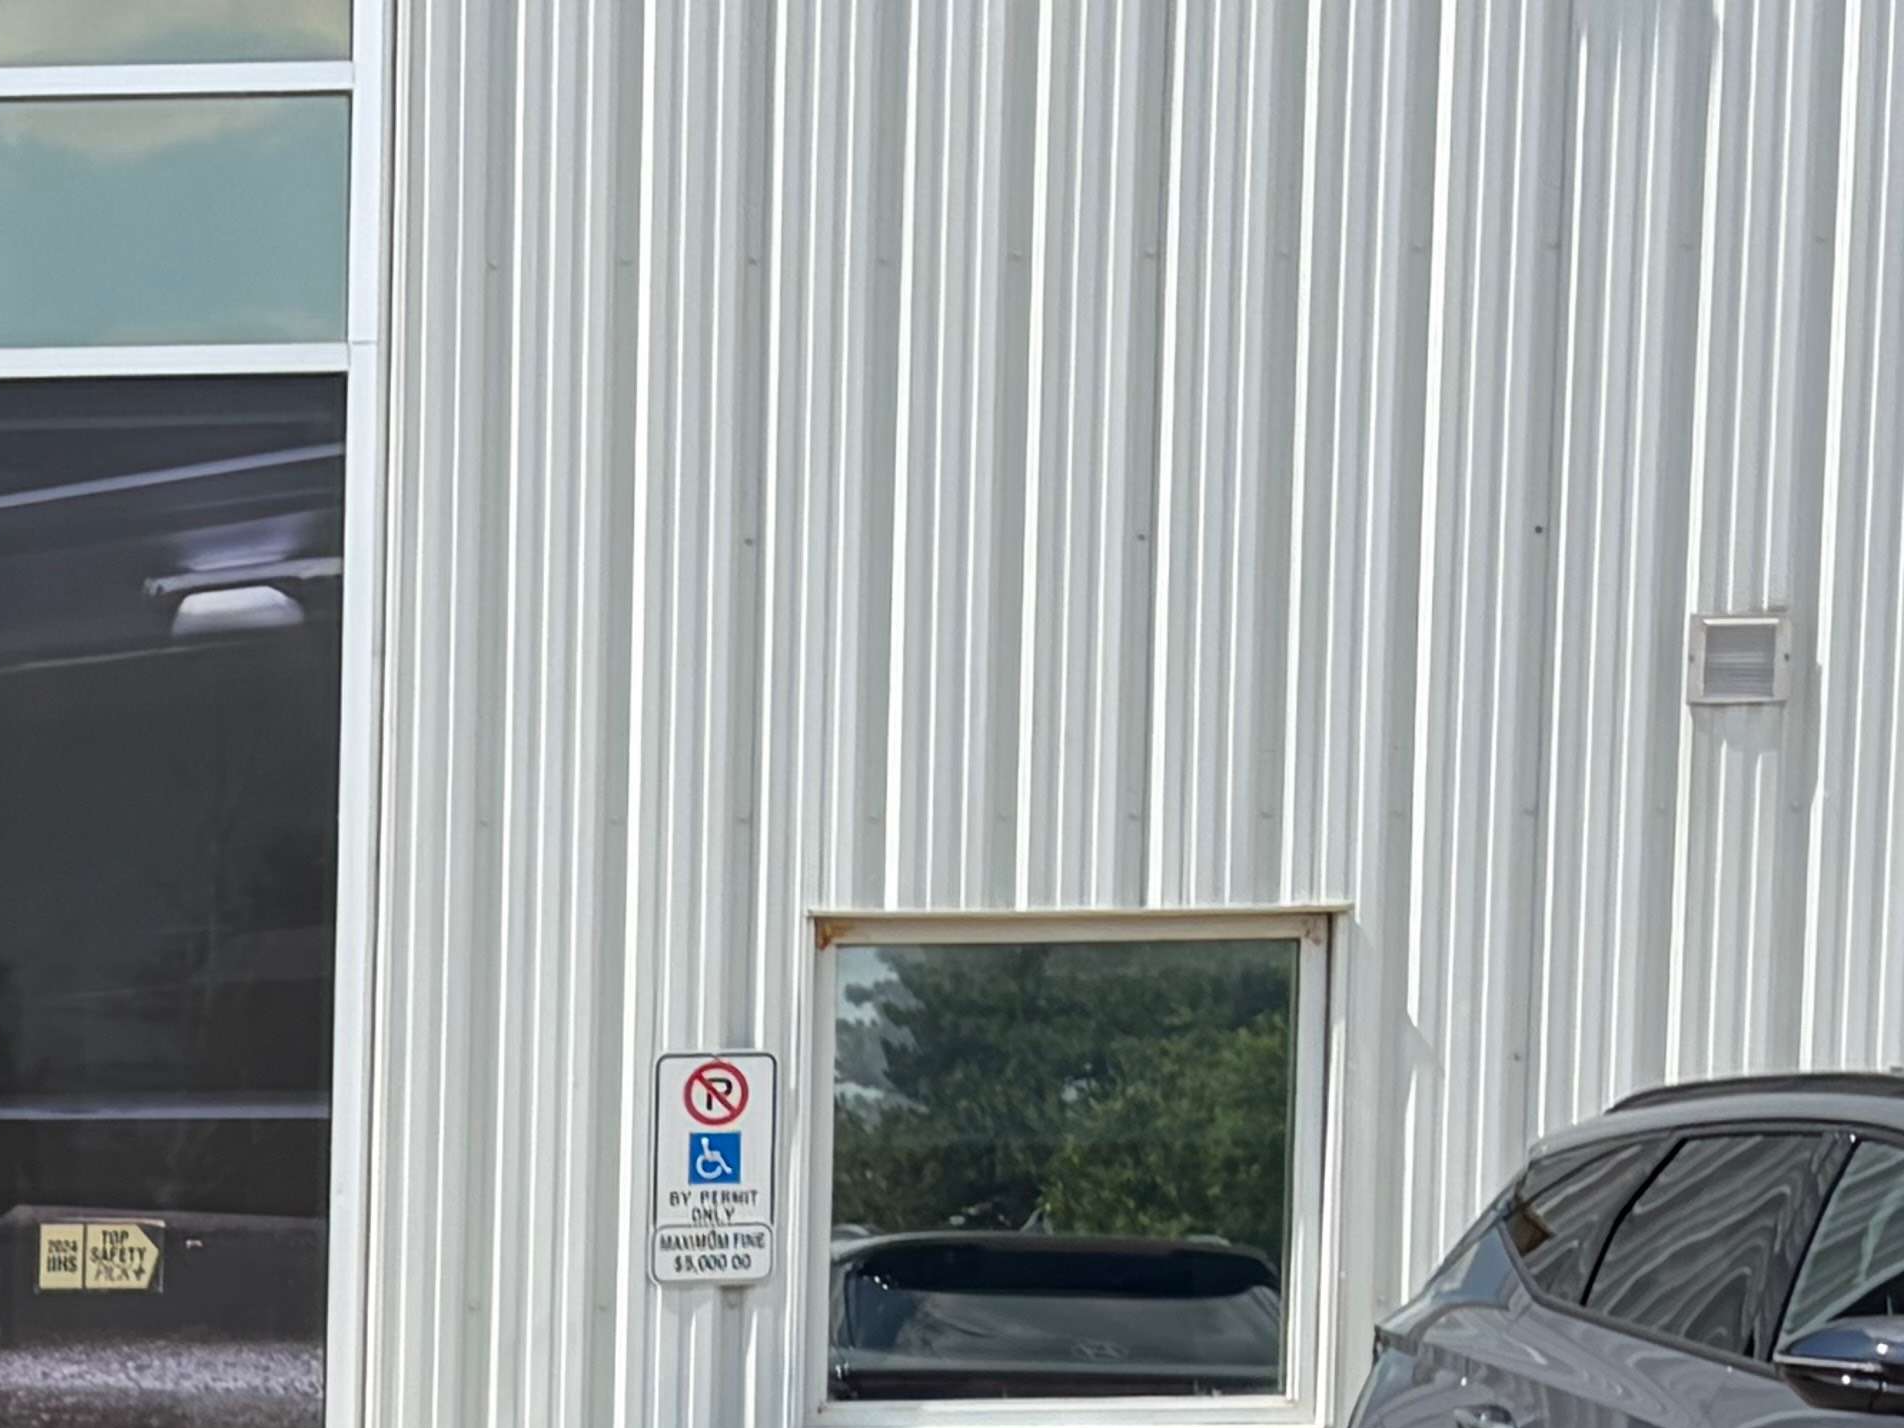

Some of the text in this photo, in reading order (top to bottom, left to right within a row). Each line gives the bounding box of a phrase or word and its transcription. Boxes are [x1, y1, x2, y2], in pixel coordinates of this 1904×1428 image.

[669, 1189, 758, 1206] BY PERMIT
[691, 1207, 735, 1223] ONLY
[101, 1229, 129, 1245] TOP
[660, 1231, 765, 1250] MAXIMUM FINE
[89, 1246, 147, 1263] SAFETY
